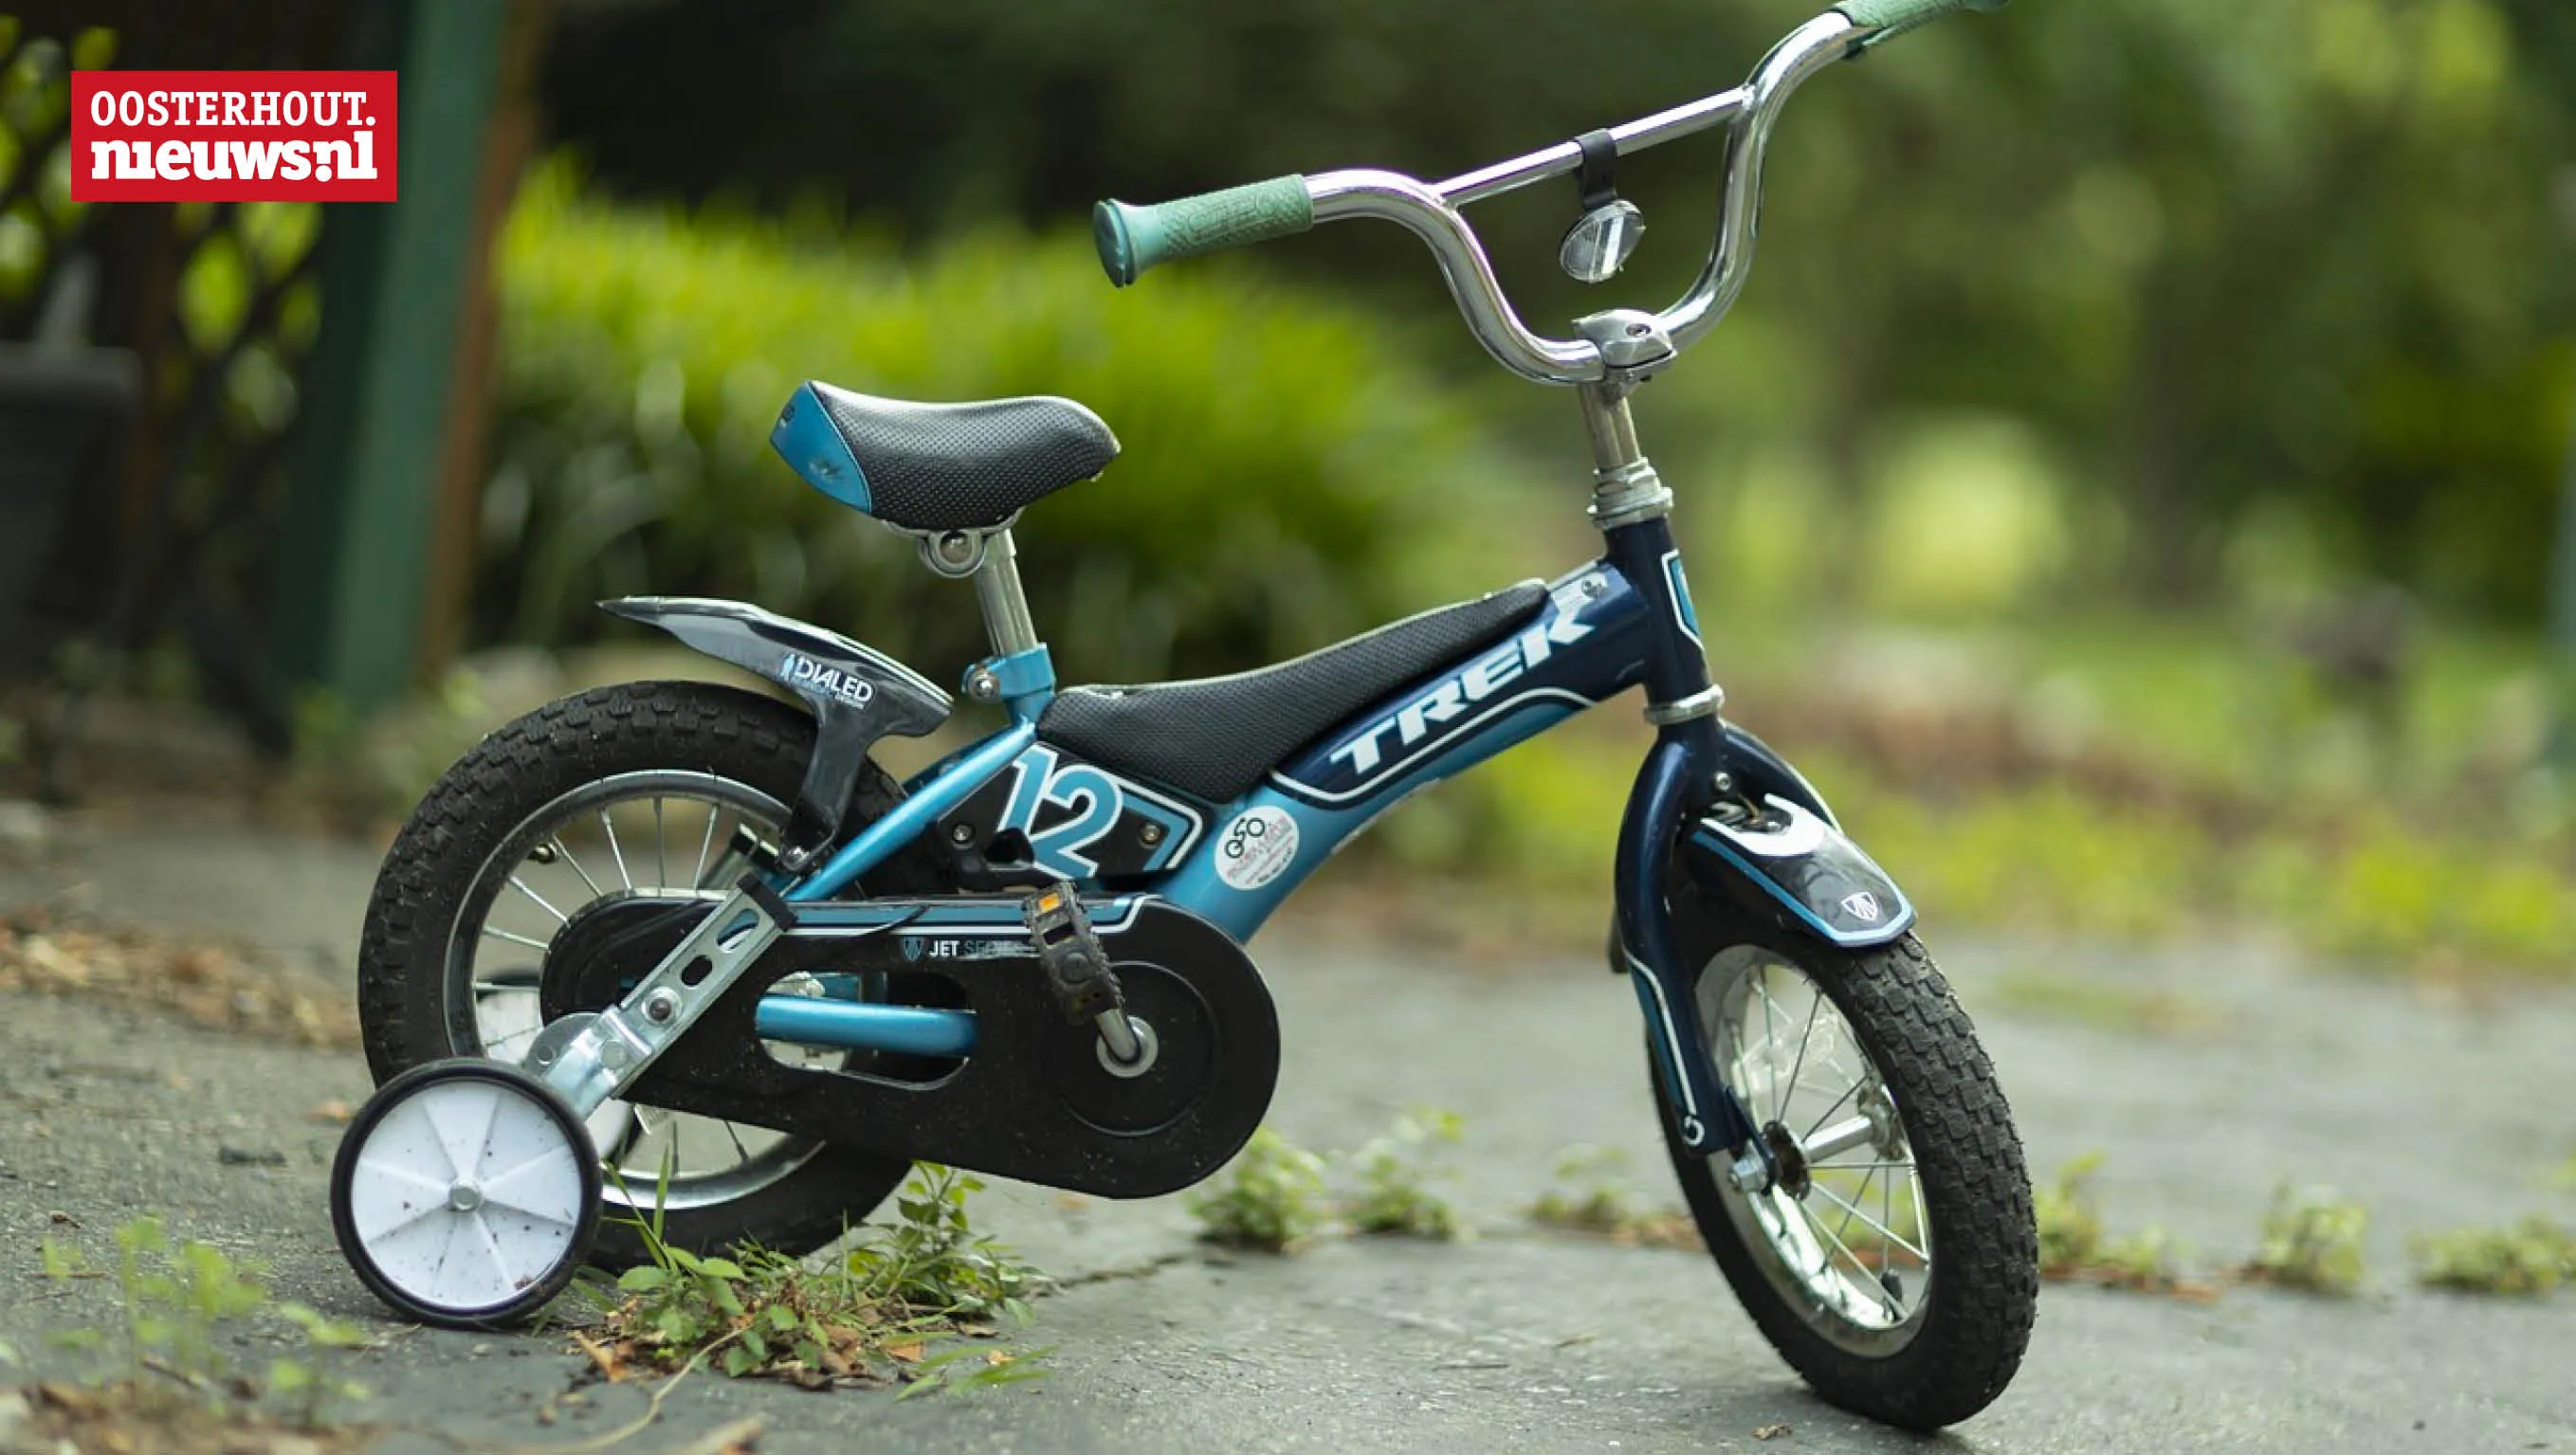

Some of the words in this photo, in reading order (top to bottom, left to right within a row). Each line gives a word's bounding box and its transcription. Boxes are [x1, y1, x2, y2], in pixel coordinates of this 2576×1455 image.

[795, 656, 873, 702] DIALED
[1329, 572, 1608, 775] TREK
[996, 742, 1124, 880] 12
[929, 939, 959, 957] JET
